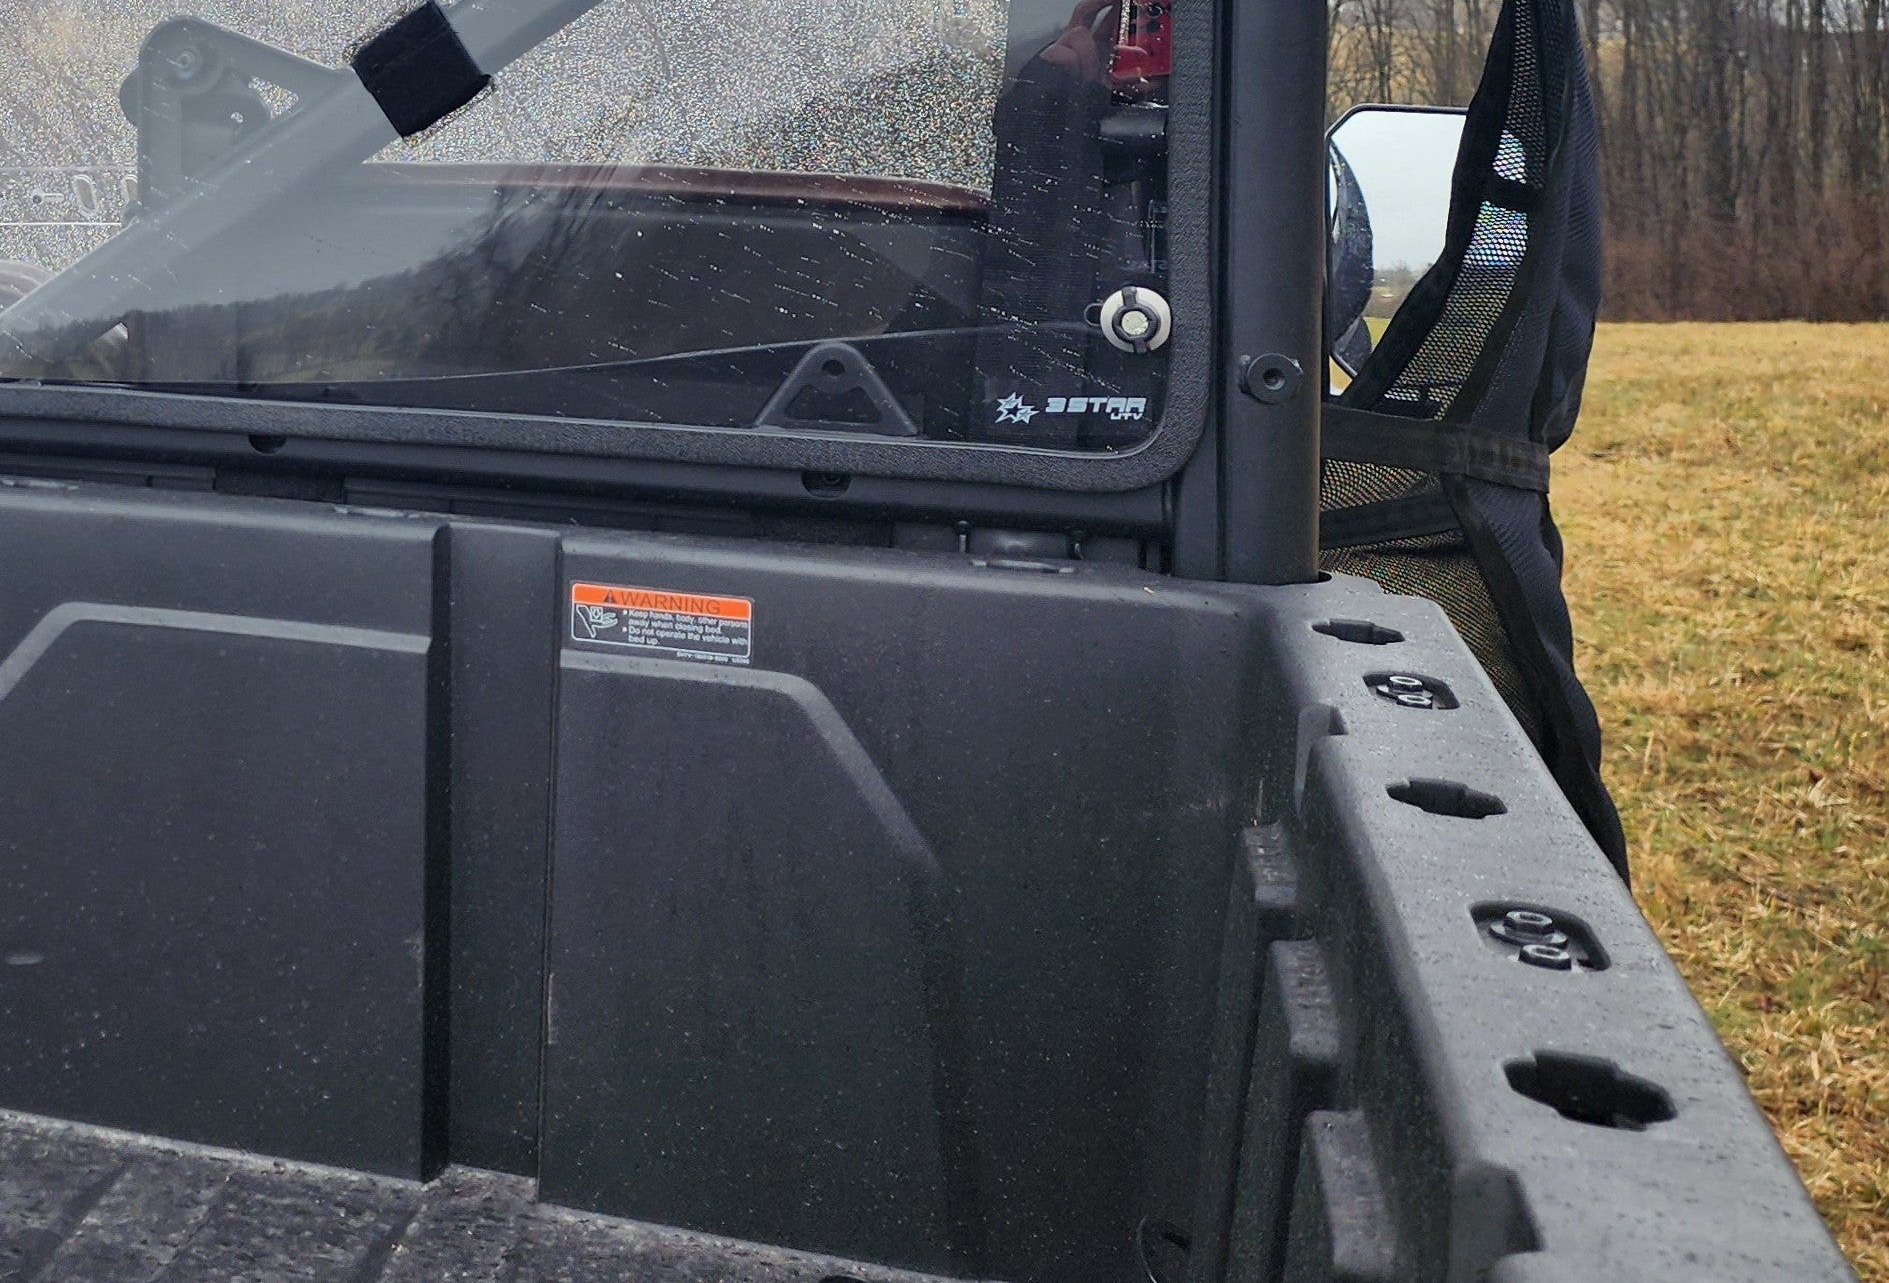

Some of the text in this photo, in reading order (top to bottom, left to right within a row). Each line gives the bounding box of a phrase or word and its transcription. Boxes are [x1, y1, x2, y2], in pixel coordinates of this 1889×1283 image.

[1045, 397, 1147, 413] 3STAR
[1110, 412, 1143, 420] UTV
[620, 591, 721, 615] WARNING
[628, 609, 649, 619] Keep
[651, 620, 673, 628] when
[675, 622, 704, 634] closing
[628, 626, 641, 635] Do
[642, 628, 654, 636] not
[655, 630, 686, 639] operate
[687, 632, 701, 641] the
[702, 634, 730, 644] vehicle
[628, 635, 645, 643] bed
